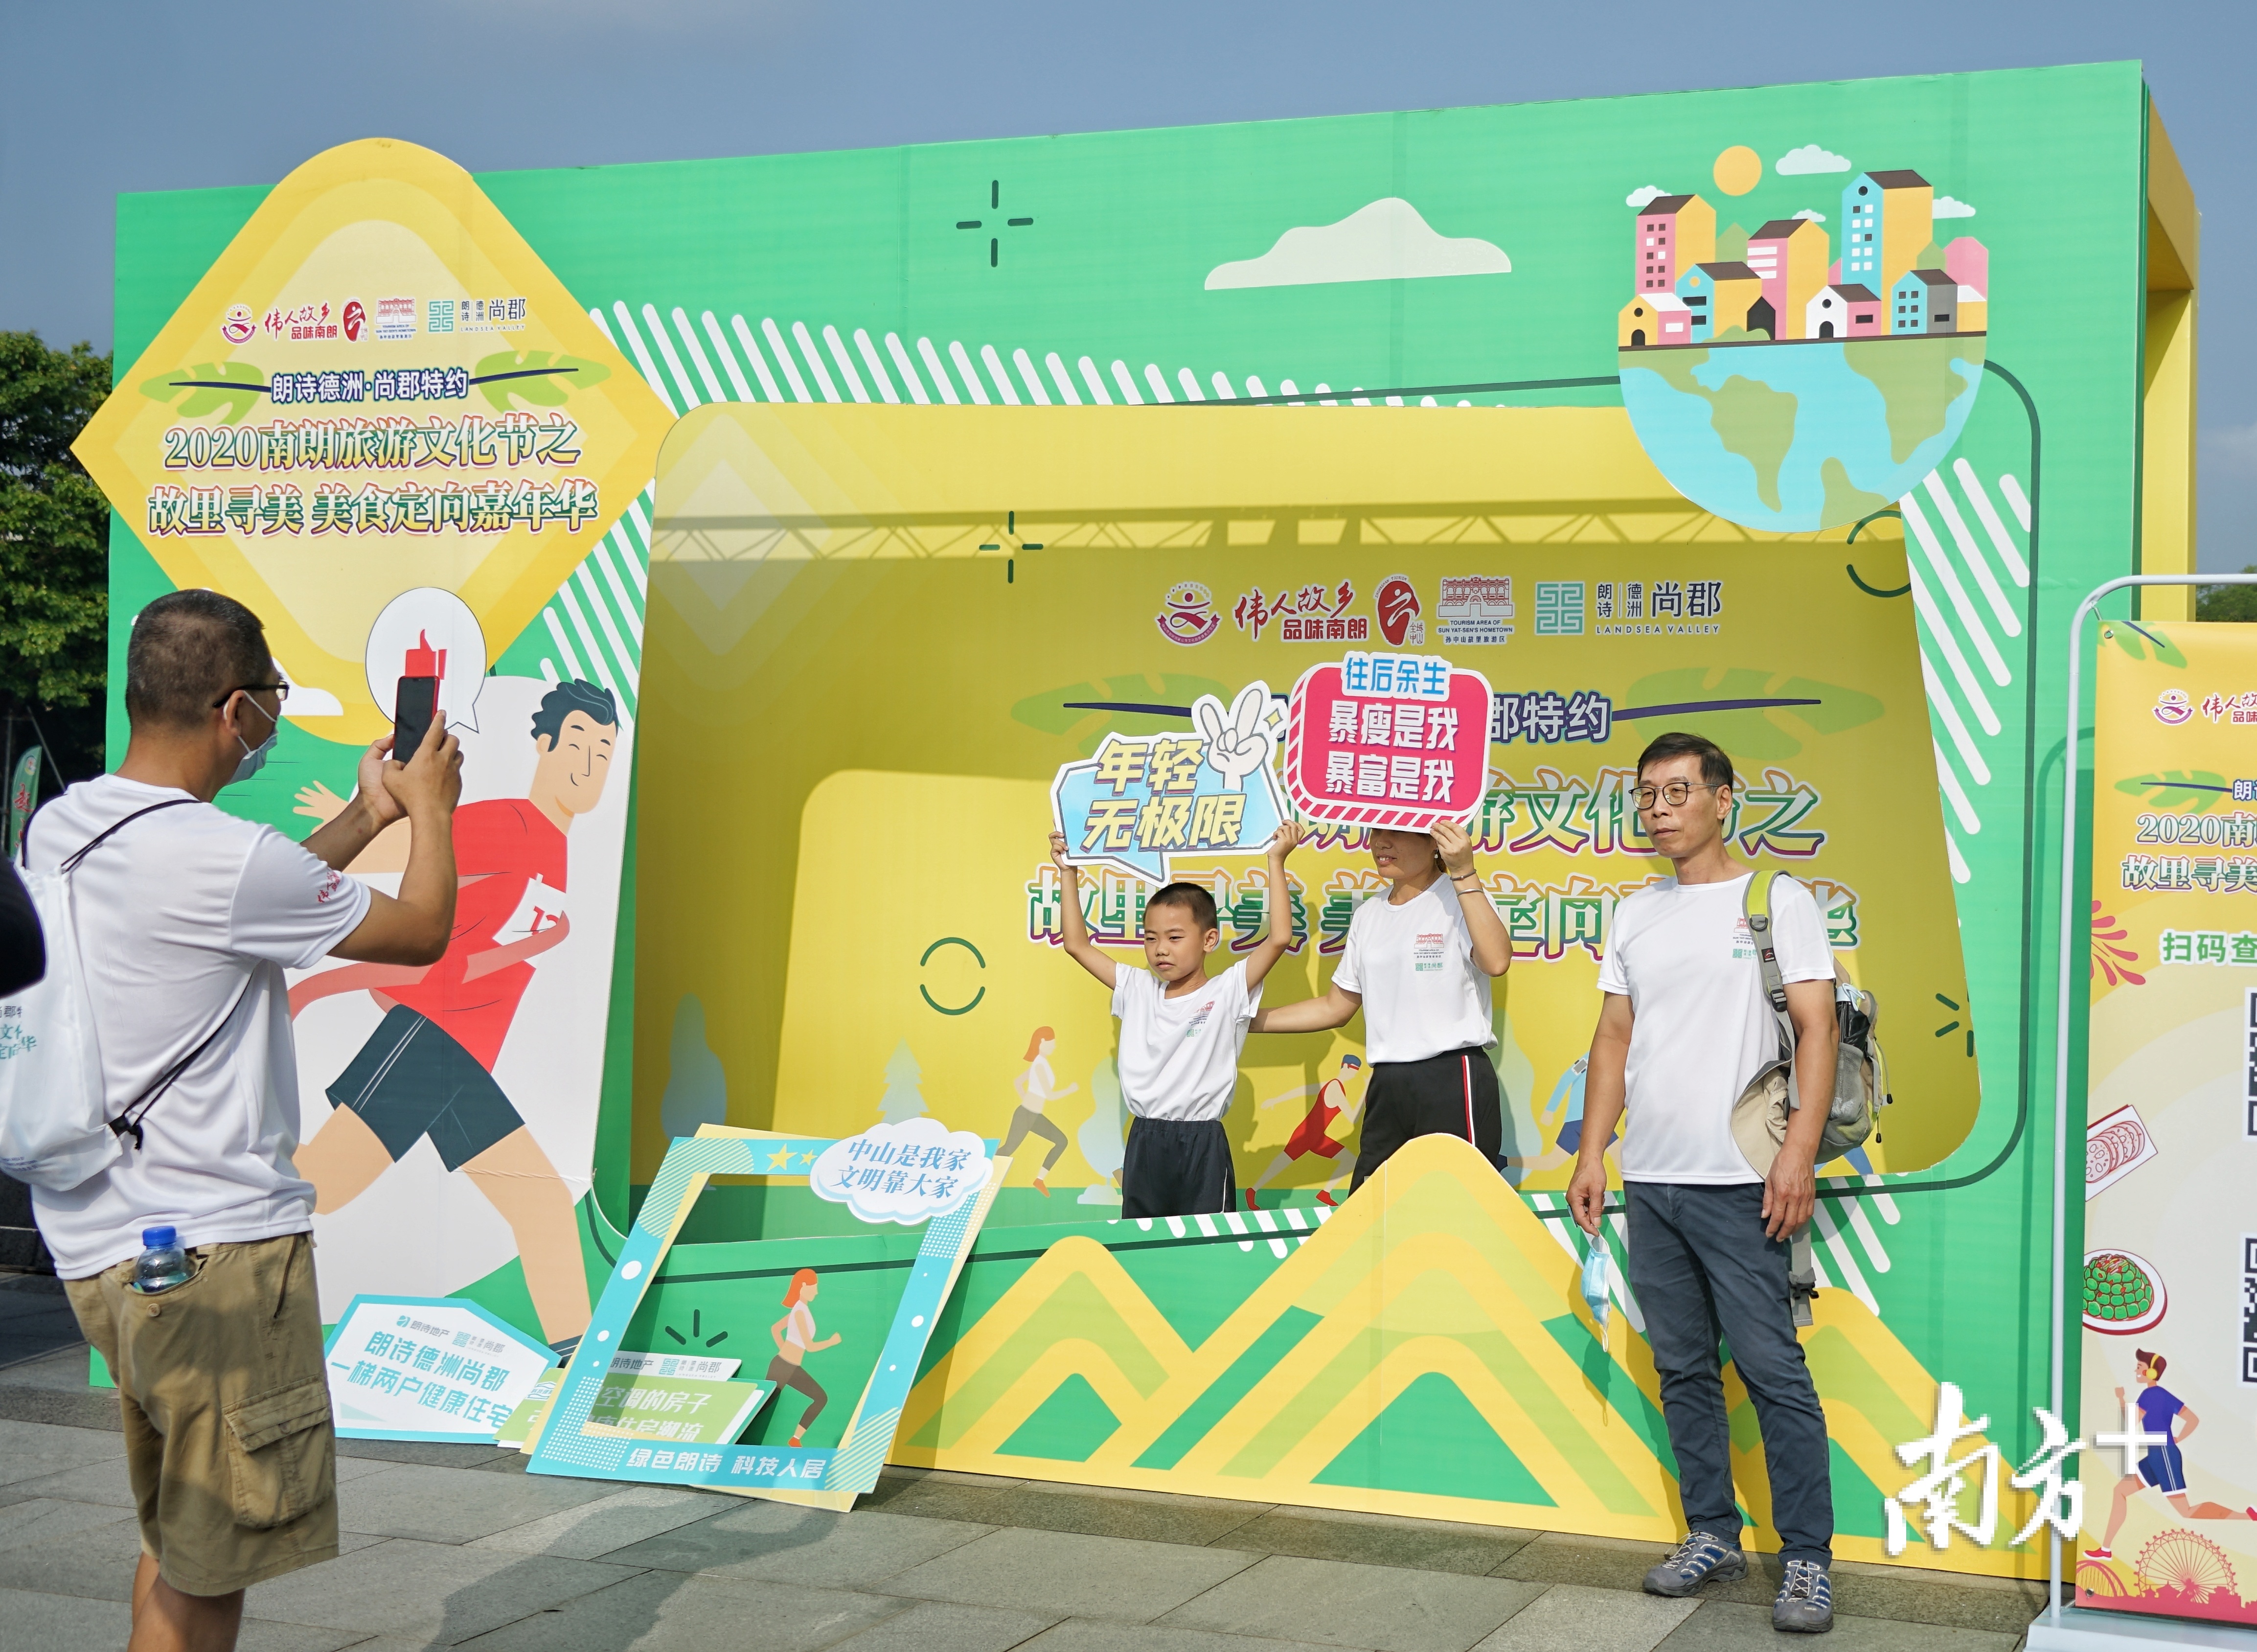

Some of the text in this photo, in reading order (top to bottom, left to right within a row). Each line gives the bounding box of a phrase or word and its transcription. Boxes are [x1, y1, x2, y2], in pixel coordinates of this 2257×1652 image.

[265, 302, 330, 340] 伟人故乡
[489, 298, 526, 321] 尚郡
[291, 325, 338, 340] 品味南朗
[164, 412, 581, 471] 2020南朗旅游文化节之
[147, 479, 598, 536] 故里寻美 美食定向嘉年华
[1234, 581, 1354, 640] 伟人故乡
[1597, 584, 1612, 618] 朗诗
[1627, 583, 1642, 617] 德洲
[1652, 582, 1722, 617] 尚郡
[1283, 619, 1368, 641] 品味南朗
[1345, 657, 1447, 695] 往后余生
[1327, 699, 1459, 752] 暴瘦是我
[1093, 737, 1205, 797] 年轻
[1324, 750, 1455, 804] 暴富是我
[1079, 793, 1248, 853] 无极限
[2121, 854, 2257, 894] 故里寻美
[2163, 932, 2257, 963] 扫码查
[847, 1138, 972, 1172] 中山是我家
[829, 1164, 960, 1199] 文明靠大家
[410, 1320, 450, 1337] 朗诗地产
[364, 1330, 511, 1392] 朗诗德洲尚郡
[696, 1361, 722, 1374] 尚郡
[330, 1359, 514, 1429] 一梯两户健康住宅
[626, 1448, 827, 1479] 绿色朗诗 科技人居
